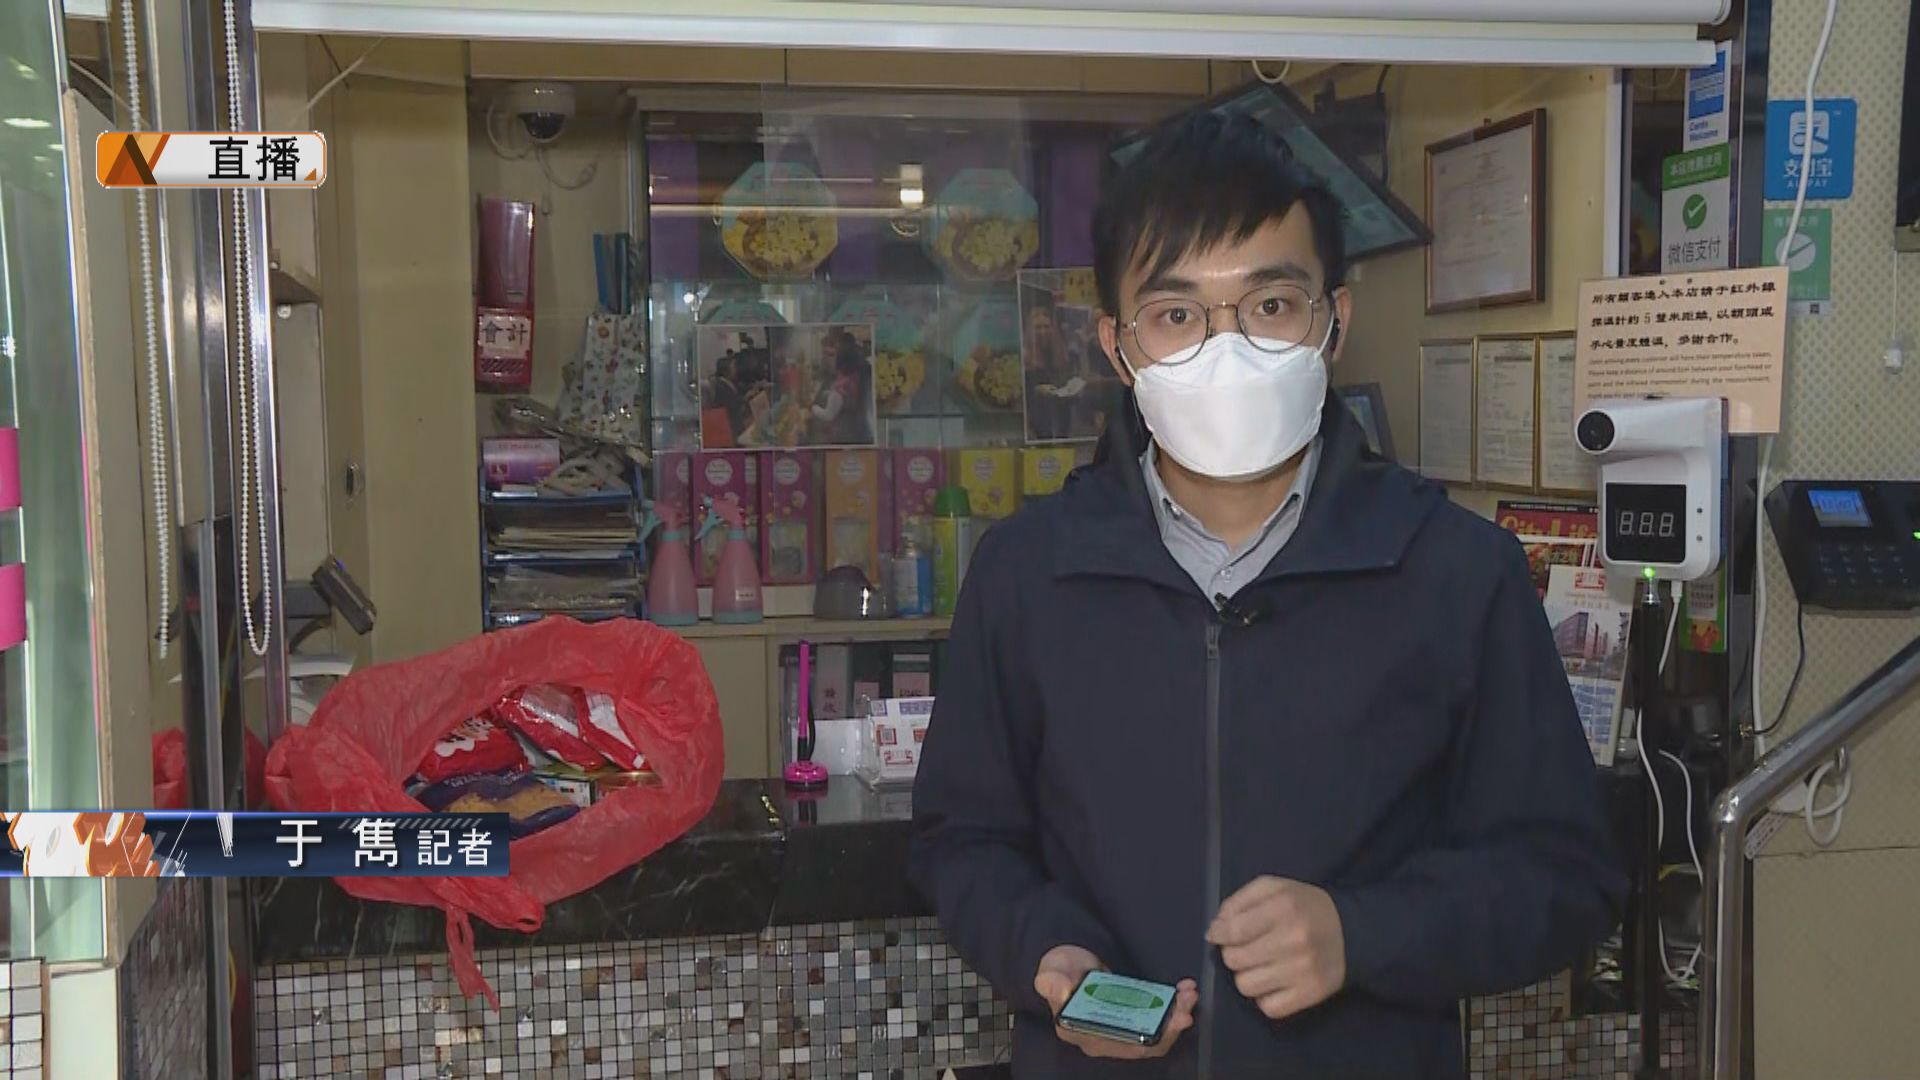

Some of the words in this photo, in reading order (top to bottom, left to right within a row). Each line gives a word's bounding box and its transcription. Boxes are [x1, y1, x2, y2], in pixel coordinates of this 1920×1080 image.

[1668, 236, 1721, 265] 微信支付
[481, 320, 529, 346] 會計
